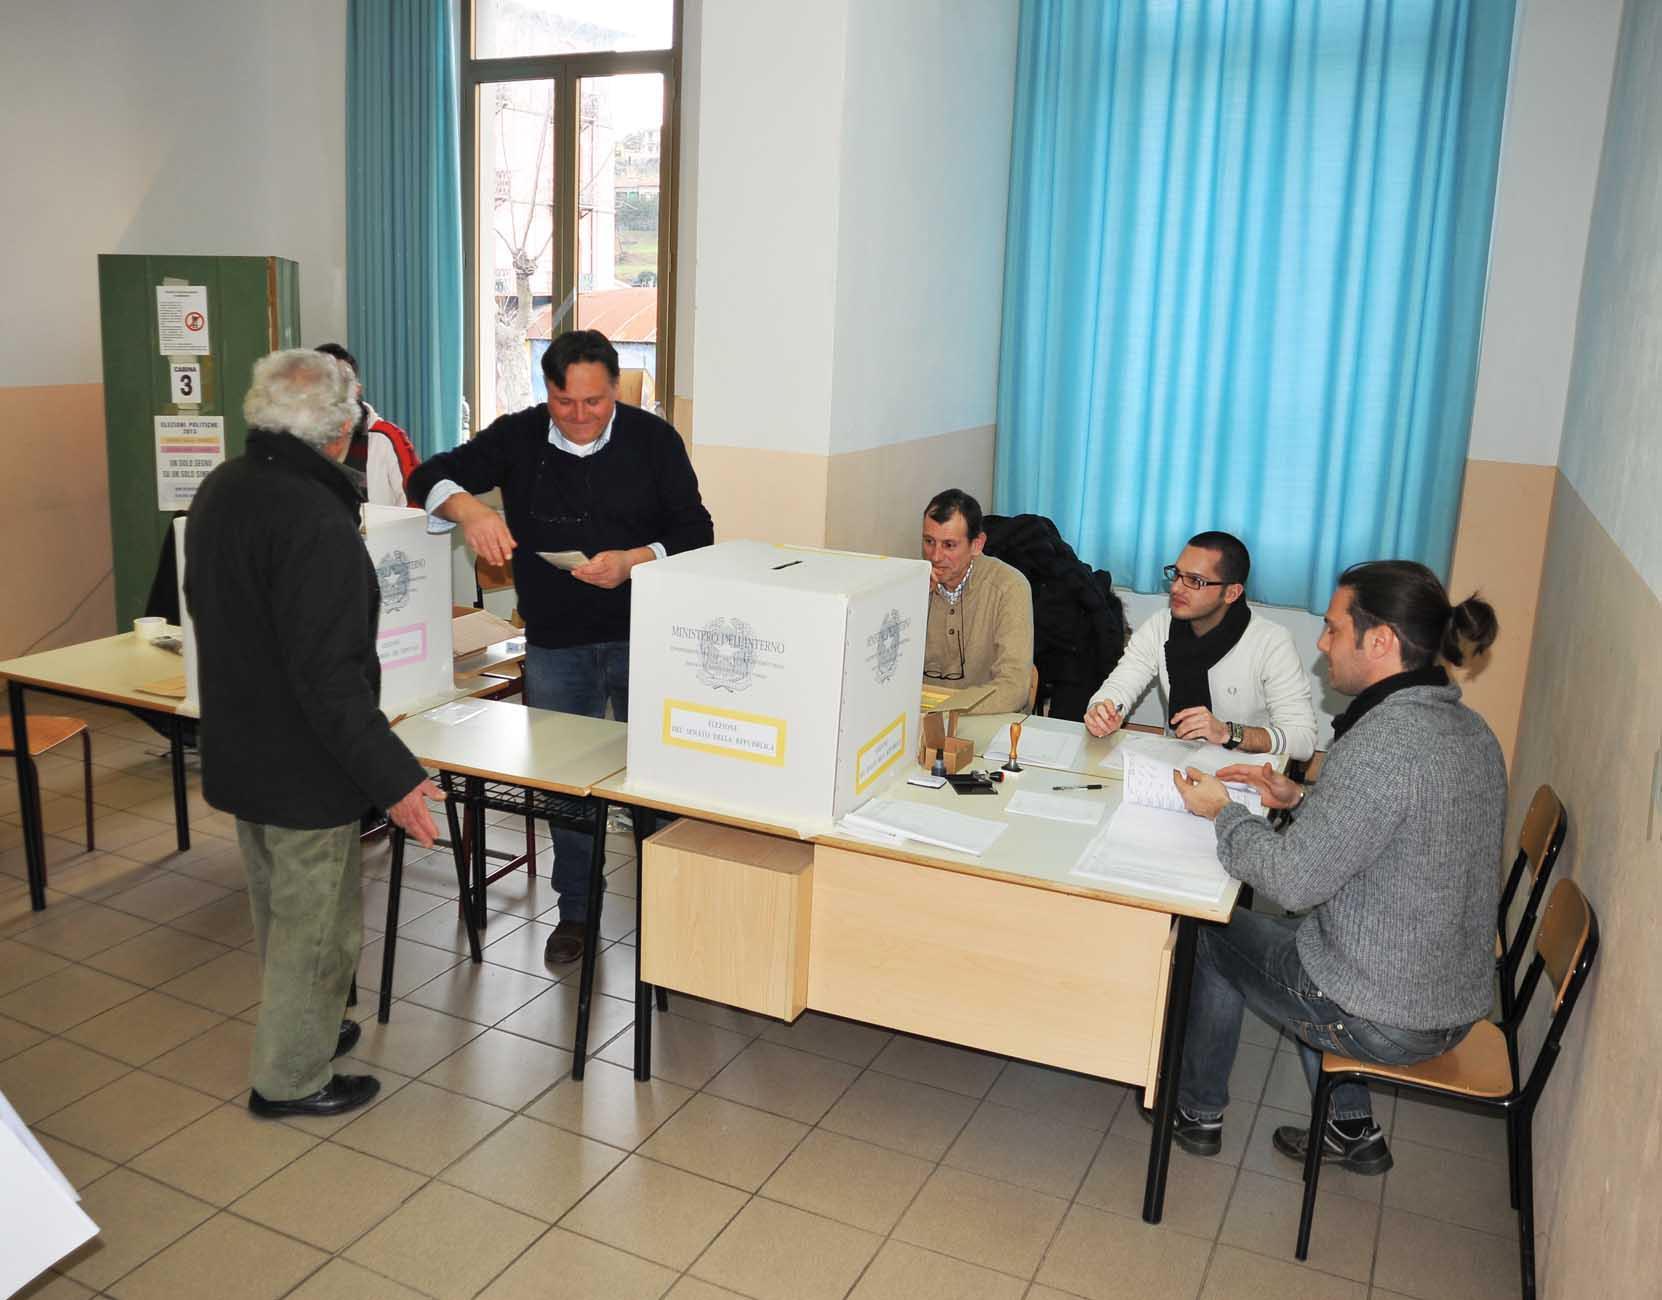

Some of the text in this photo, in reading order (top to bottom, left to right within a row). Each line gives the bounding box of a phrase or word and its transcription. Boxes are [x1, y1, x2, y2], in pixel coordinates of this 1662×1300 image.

[180, 374, 193, 396] 3
[671, 625, 720, 646] MINISTERO
[686, 728, 711, 740] SENATO
[713, 733, 732, 743] DELLA
